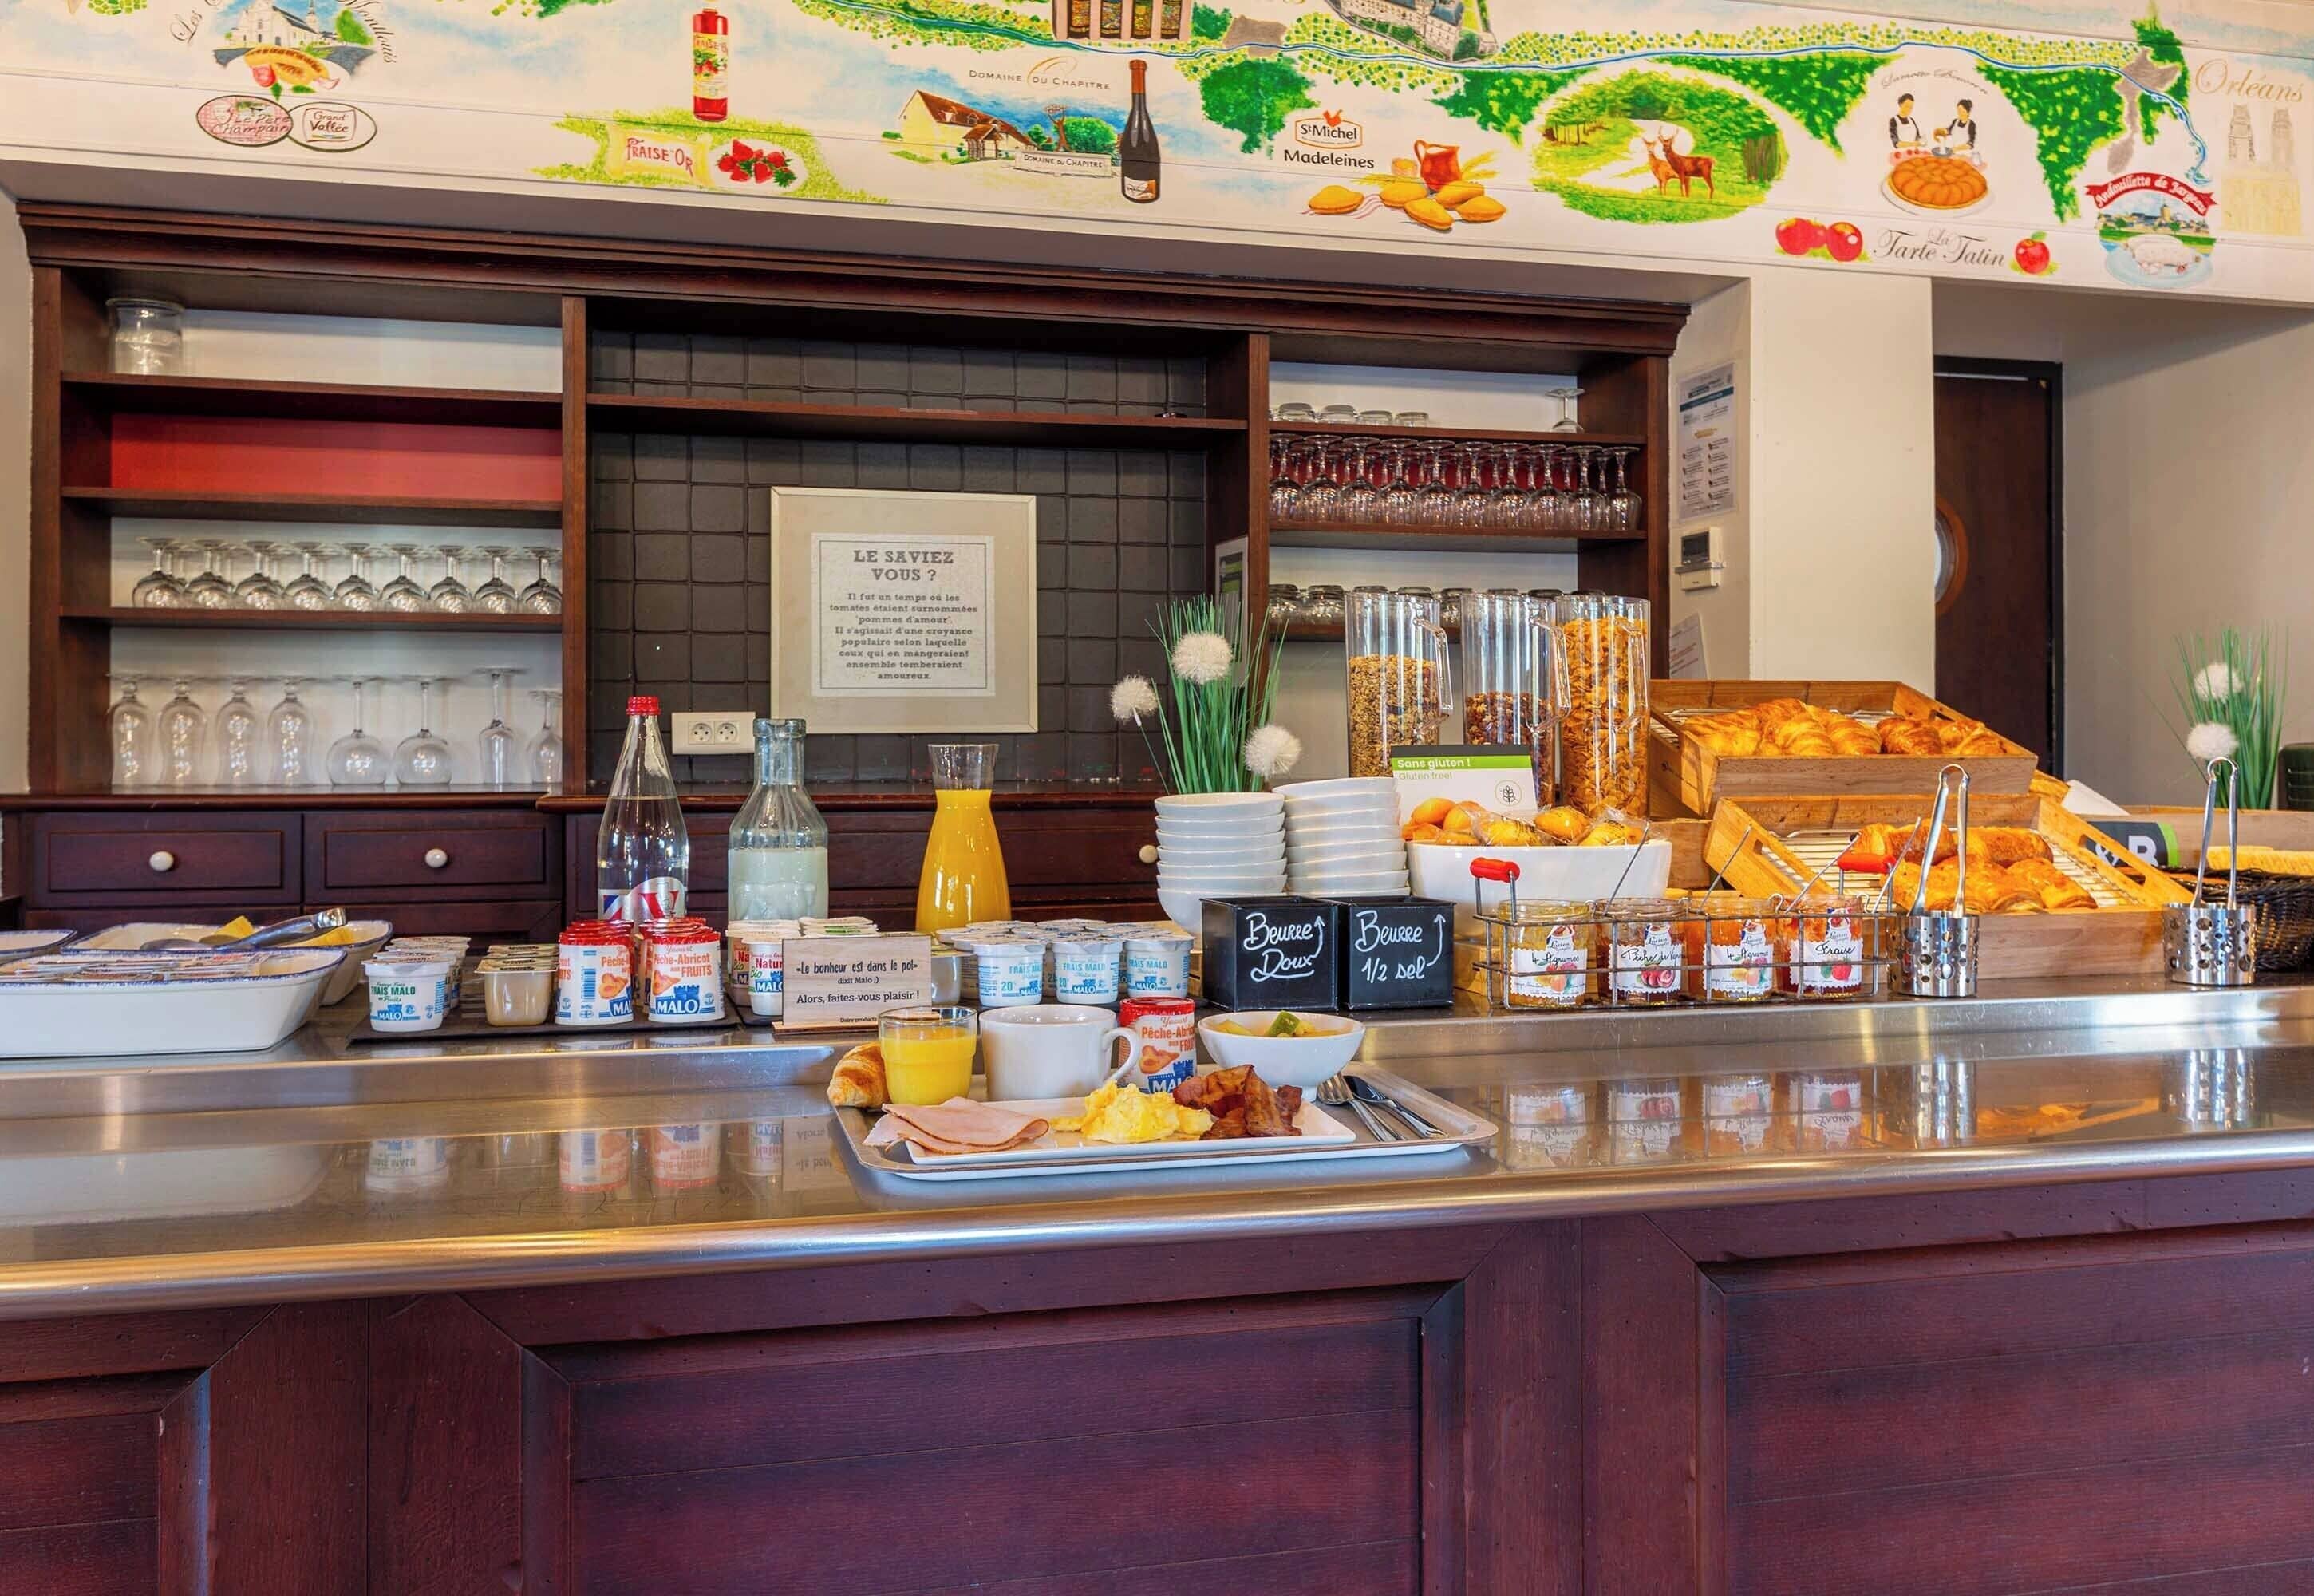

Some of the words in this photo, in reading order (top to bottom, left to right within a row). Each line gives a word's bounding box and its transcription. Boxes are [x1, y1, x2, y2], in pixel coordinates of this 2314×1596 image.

[314, 111, 346, 121] Grand
[1284, 148, 1375, 169] Madeleines
[853, 550, 879, 563] LE
[884, 551, 954, 564] SAVIEZ
[871, 568, 922, 581] VOUS
[927, 569, 937, 581] ?
[894, 594, 927, 603] temps
[847, 626, 893, 636] s'agissait
[926, 628, 973, 638] croyance
[841, 638, 890, 648] populaire
[926, 638, 967, 648] laquelle
[867, 649, 884, 658] qui
[903, 650, 969, 659] mangeraient
[846, 661, 896, 670] ensemble
[899, 661, 962, 670] tomberaient
[1398, 759, 1426, 768] Sans
[1427, 758, 1465, 771] gluten
[1243, 912, 1313, 950] Beurre
[1356, 910, 1423, 953] Beurre
[1815, 940, 1856, 956] Fraise
[1146, 960, 1168, 969] MALO
[1250, 948, 1315, 982] Doux
[1531, 952, 1539, 965] 4
[681, 965, 713, 978] FRUITS
[814, 961, 847, 974] bonheur
[851, 960, 863, 973] est
[867, 960, 887, 972] dans
[890, 959, 898, 971] le
[1063, 962, 1083, 971] FRAIS
[1085, 962, 1106, 971] MALO
[1361, 957, 1388, 984] 1/2
[1395, 955, 1426, 981] sel
[837, 976, 852, 985] dixit
[390, 986, 416, 996] MALO
[796, 994, 825, 1005] Alors,
[827, 992, 881, 1003] faites-vous
[883, 990, 914, 1003] plaisir
[657, 999, 698, 1014] MALO
[378, 1011, 401, 1020] MALO
